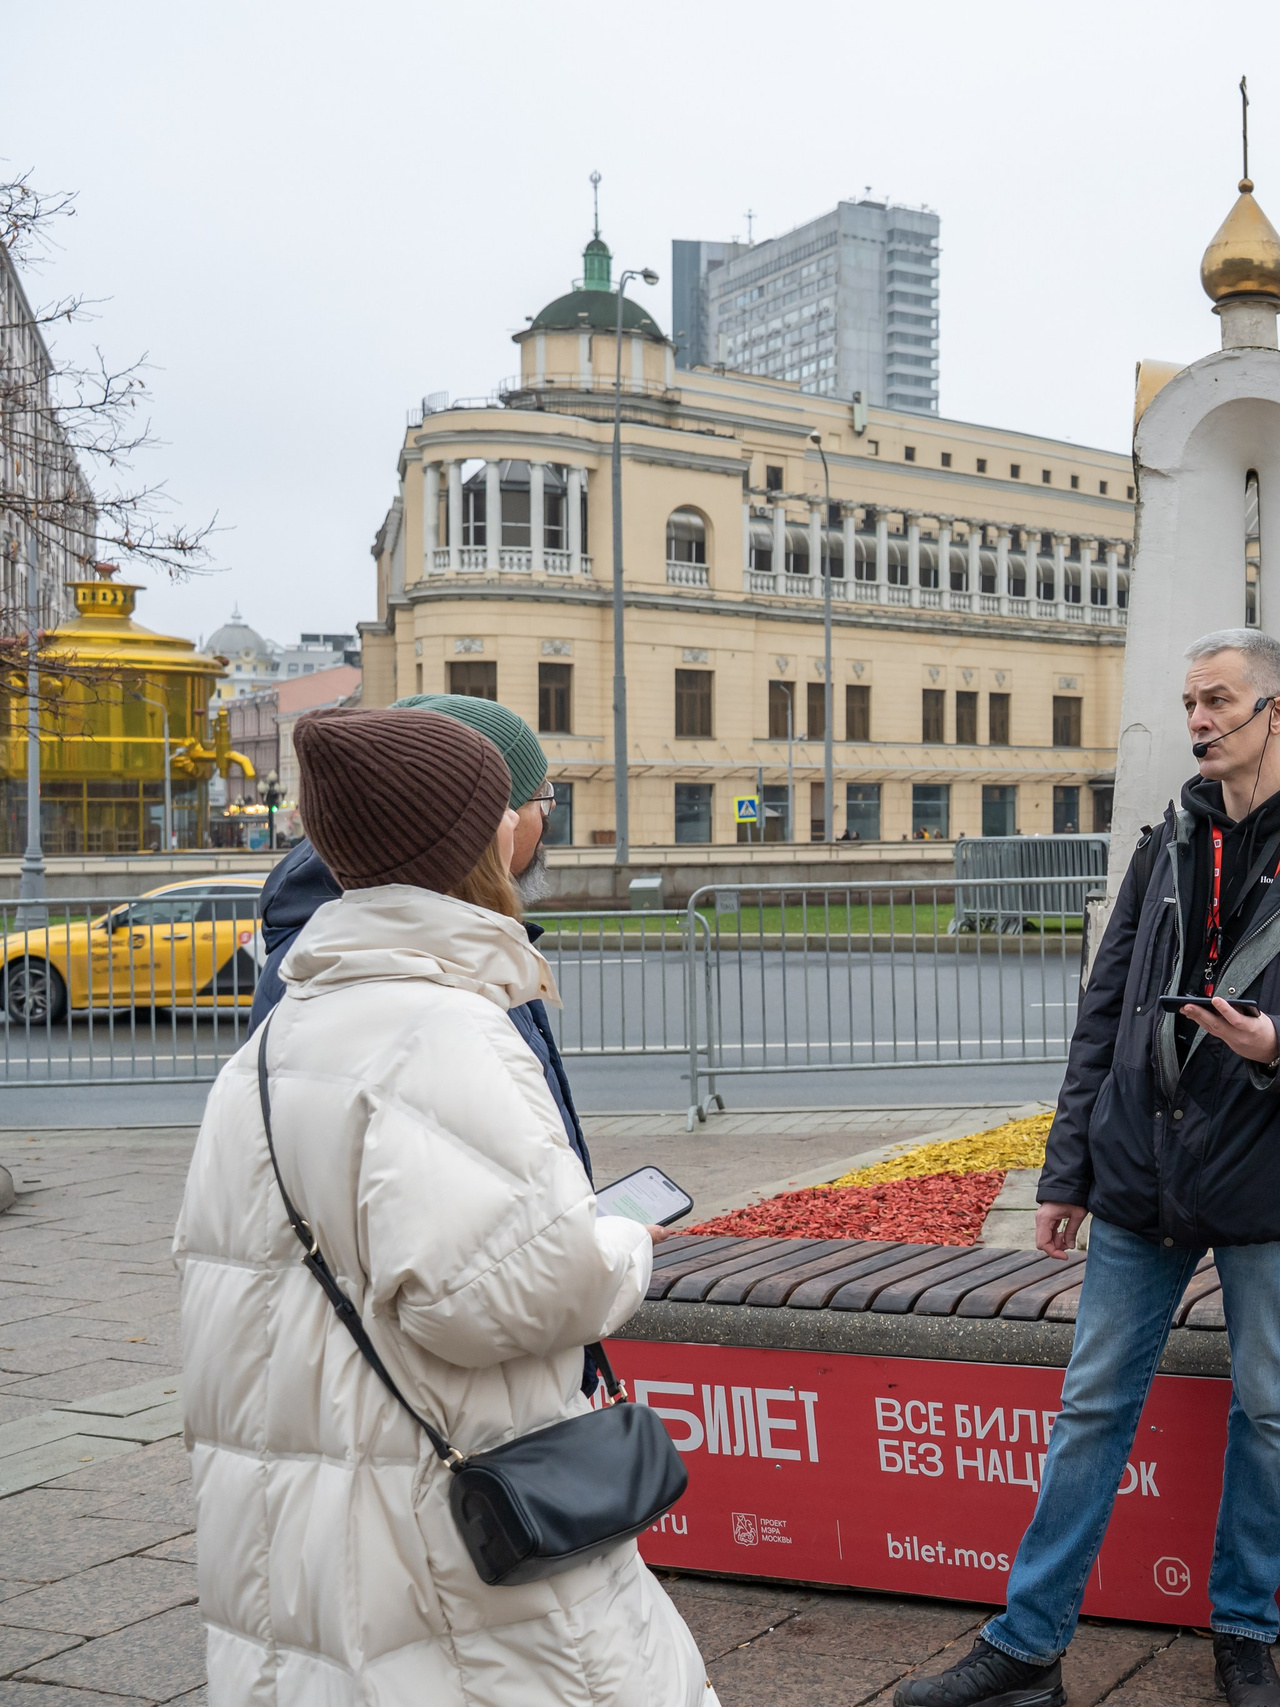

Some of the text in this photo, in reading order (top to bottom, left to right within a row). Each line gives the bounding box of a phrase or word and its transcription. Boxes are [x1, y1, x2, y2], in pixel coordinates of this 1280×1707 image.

[875, 1397, 946, 1436] ВСЕ
[878, 1438, 1160, 1497] БЕЗ НАЦОК
[760, 1518, 787, 1528] ПРОЕКТ
[761, 1527, 781, 1535] МЭРА
[762, 1534, 793, 1544] МОСКВЫ
[887, 1533, 1010, 1572] bilet.mos
[1165, 1565, 1189, 1587] 0+
